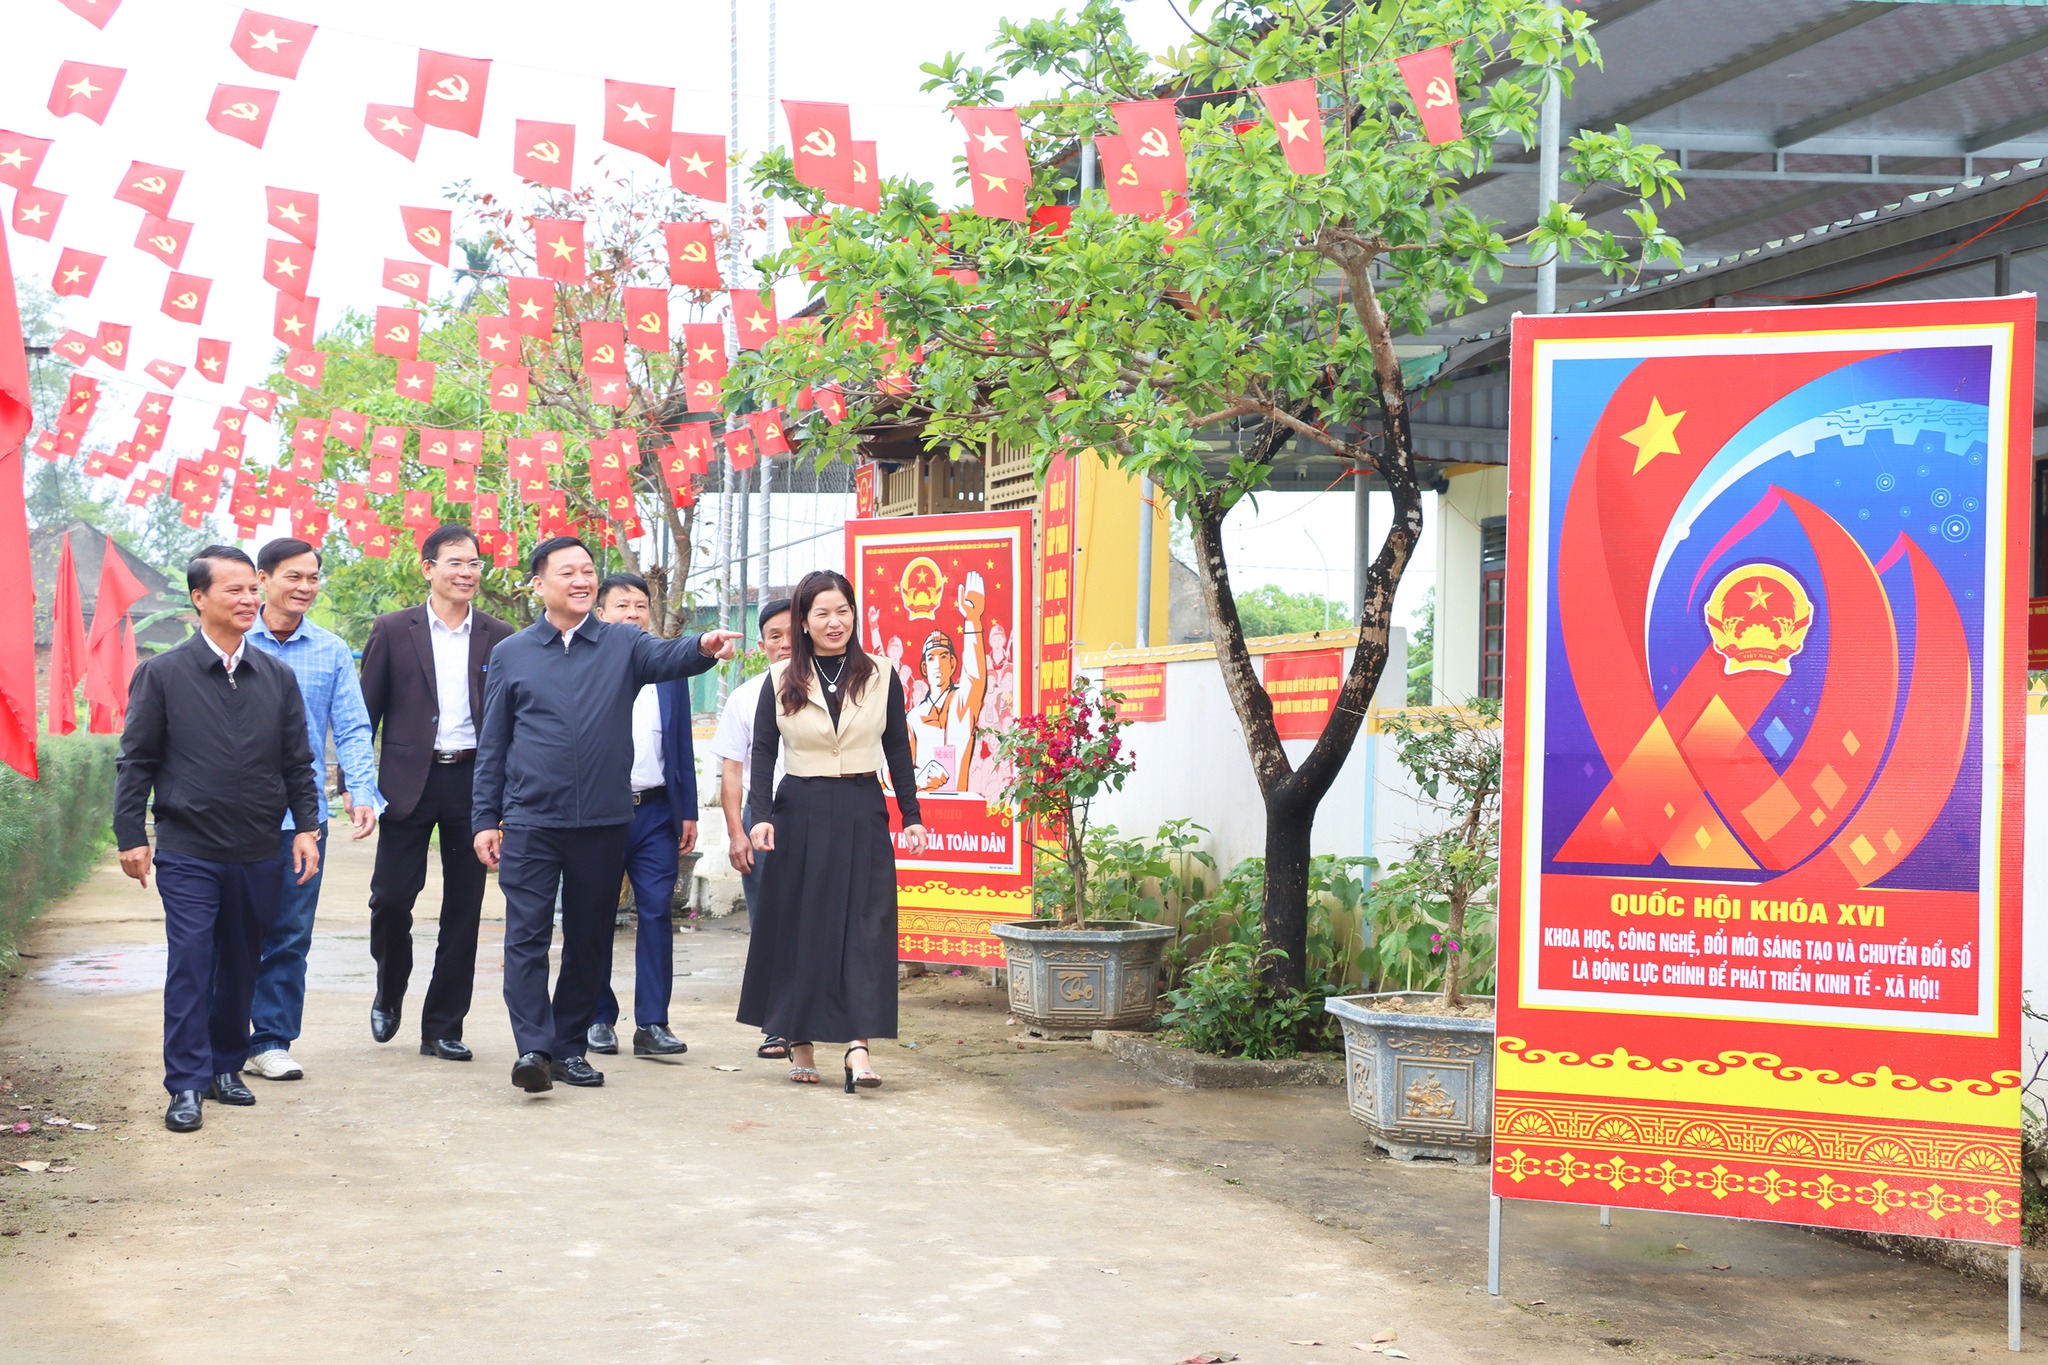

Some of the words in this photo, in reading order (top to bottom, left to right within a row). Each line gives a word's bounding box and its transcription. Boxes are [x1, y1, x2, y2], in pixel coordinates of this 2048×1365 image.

[946, 831, 978, 851] TOÀN
[981, 832, 1005, 852] DÂN
[1610, 888, 1684, 917] QUỐC
[1694, 894, 1741, 923] HỘI
[1750, 898, 1828, 924] KHÓA
[1837, 904, 1885, 927] XVI
[1544, 927, 1580, 947] KHOA
[1583, 929, 1615, 953] HỌC,
[1618, 927, 1655, 951] CÔNG
[1660, 930, 1700, 957] NGHỆ,
[1704, 928, 1728, 955] ĐỔI
[1732, 932, 1759, 956] MỚI
[1763, 935, 1801, 959] SÁNG
[1806, 940, 1833, 965] TẠO
[1837, 939, 1855, 963] VÀ
[1859, 937, 1917, 966] CHUYỂN
[1921, 939, 1947, 968] ĐỔI
[1951, 942, 1971, 969] SỐ
[1572, 956, 1589, 979] LÀ
[1592, 958, 1630, 985] ĐỘNG
[1633, 961, 1659, 987] LỰC
[1662, 961, 1705, 986] CHÍNH
[1708, 960, 1728, 987] ĐỂ
[1730, 965, 1766, 990] PHÁT
[1770, 964, 1811, 993] TRIỂN
[1815, 973, 1850, 995] KINH
[1854, 969, 1873, 996] TẾ
[1885, 974, 1906, 999] XÃ
[1909, 975, 1940, 1004] HỘI!
